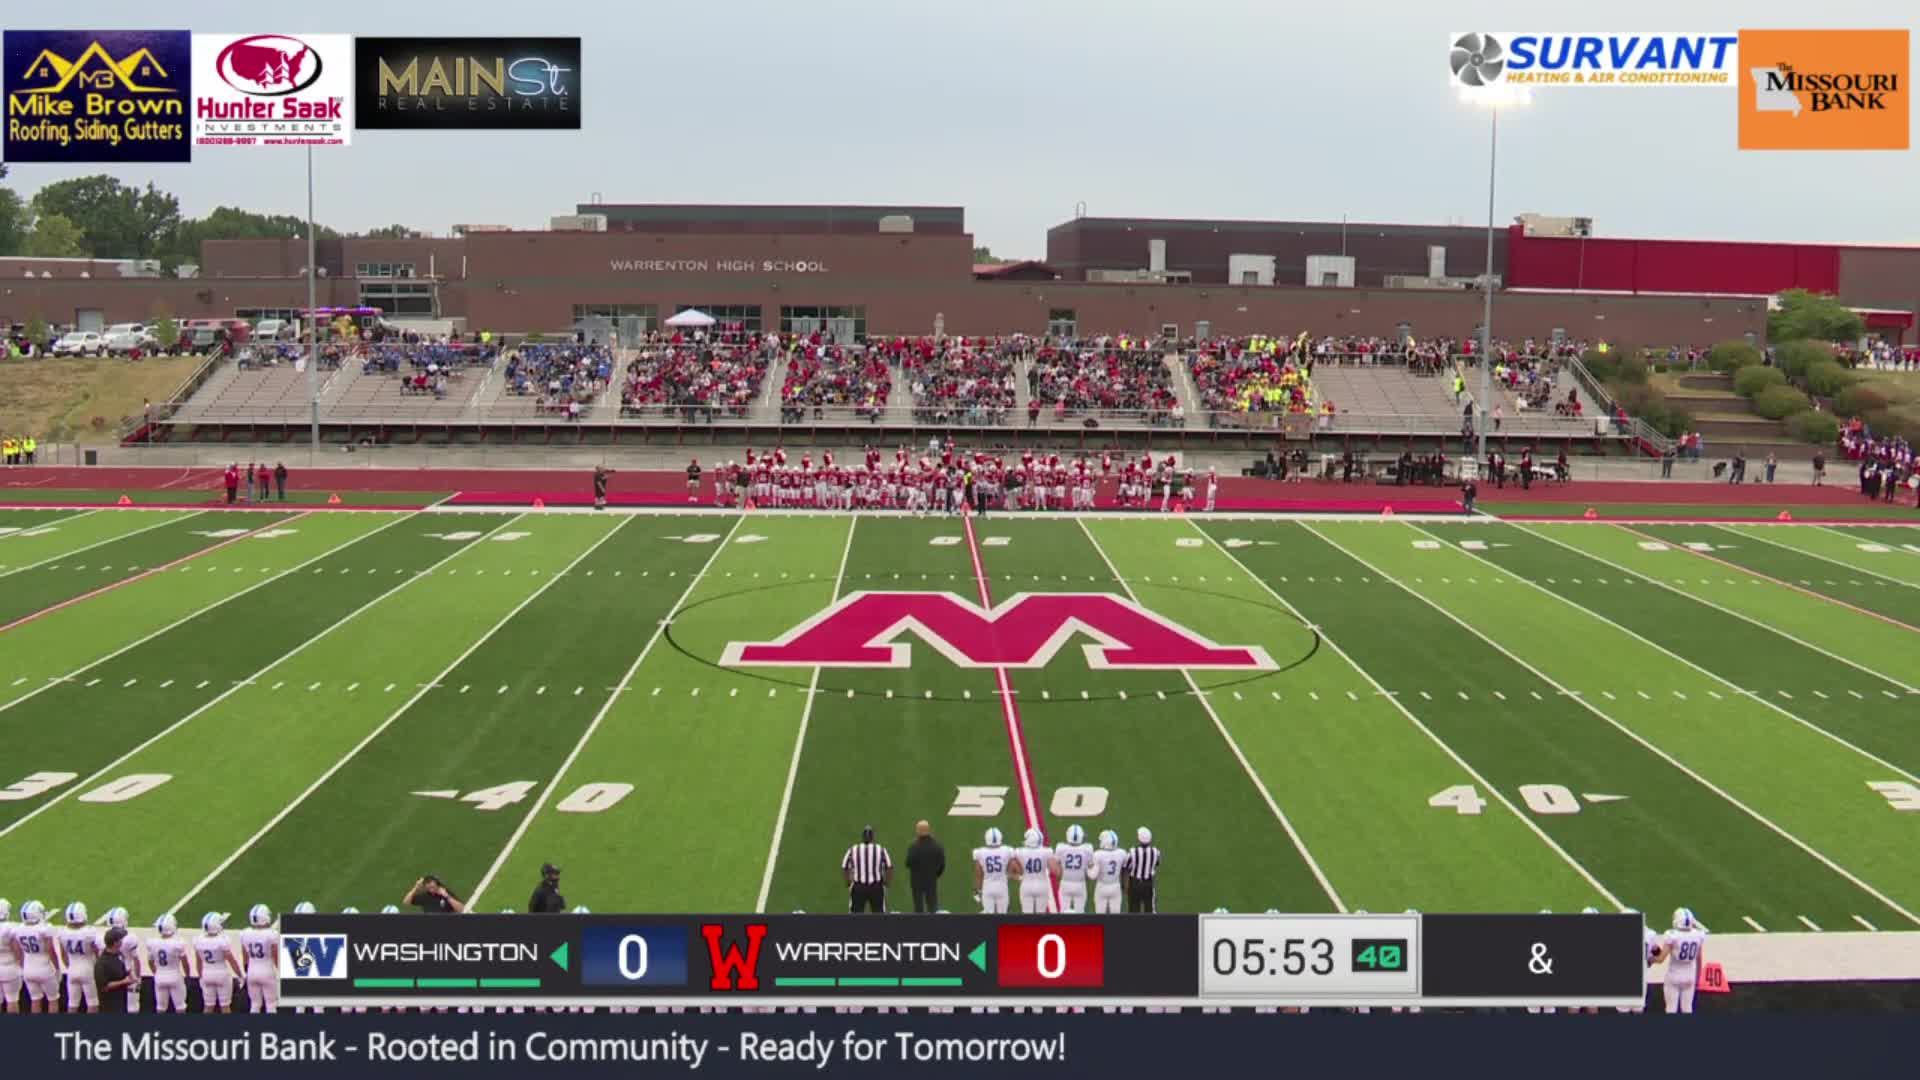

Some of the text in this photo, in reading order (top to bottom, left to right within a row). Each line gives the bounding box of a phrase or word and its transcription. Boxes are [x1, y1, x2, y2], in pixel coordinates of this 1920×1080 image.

[610, 259, 829, 272] WARRENTON HIGH SCHOOL
[986, 856, 1002, 873] 65
[1025, 858, 1042, 874] 40
[1065, 854, 1083, 870] 23
[1107, 861, 1117, 875] 3
[20, 936, 40, 954] 56
[66, 940, 85, 955] 44
[1679, 942, 1697, 961] 80
[158, 950, 168, 966] 8
[204, 950, 216, 964] 2
[1705, 967, 1722, 987] 40
